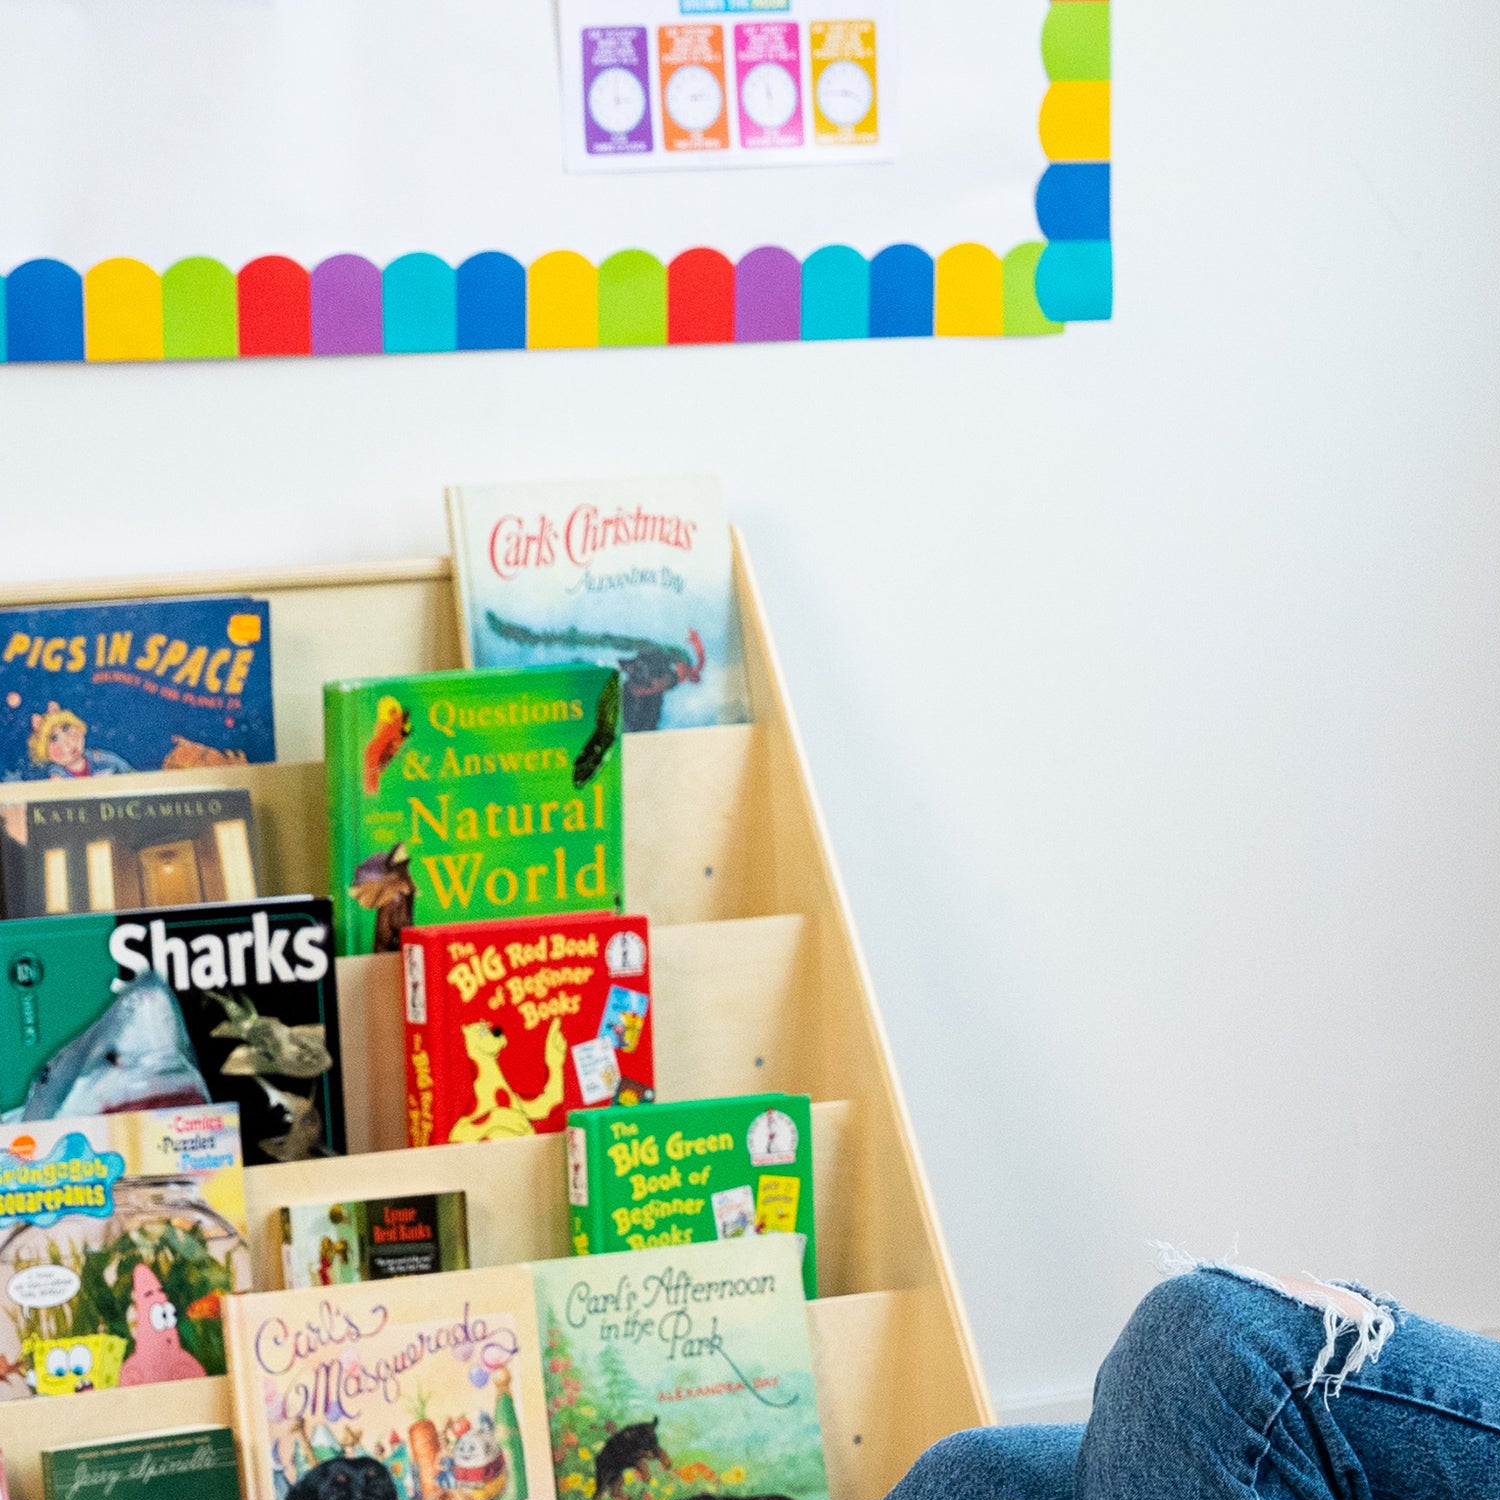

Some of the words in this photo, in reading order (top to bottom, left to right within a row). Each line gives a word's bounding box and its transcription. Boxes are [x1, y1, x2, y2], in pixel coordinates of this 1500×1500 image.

[487, 514, 559, 581] Carl's
[564, 502, 698, 568] Christmas
[3, 631, 87, 672] PIGS
[95, 631, 132, 667] IN
[136, 633, 254, 694] SPACE
[428, 693, 584, 737] Questions
[402, 750, 431, 781] &
[439, 747, 569, 778] Answers
[408, 784, 605, 844] Natural
[421, 844, 607, 910] World
[109, 911, 329, 994] Sharks
[447, 942, 476, 960] The
[447, 946, 506, 1003] BIG
[505, 936, 548, 969] Red
[549, 933, 600, 960] Book
[488, 985, 505, 1010] of
[505, 967, 594, 1005] Beginner
[518, 991, 581, 1031] Books
[163, 1134, 217, 1153] Puzzles
[174, 1115, 224, 1133] Comics
[610, 1122, 639, 1140] The
[607, 1135, 660, 1176] BIG
[665, 1131, 734, 1160] Green
[629, 1166, 682, 1200] Book
[688, 1165, 711, 1185] of
[611, 1197, 705, 1236] Beginner
[626, 1224, 693, 1251] Books
[565, 1274, 637, 1328] Carl's
[642, 1266, 776, 1309] Afternoon
[255, 1300, 388, 1376] Carl's
[600, 1318, 620, 1341] in
[623, 1311, 654, 1344] the
[658, 1307, 723, 1360] Park
[281, 1301, 519, 1420] Masquerade
